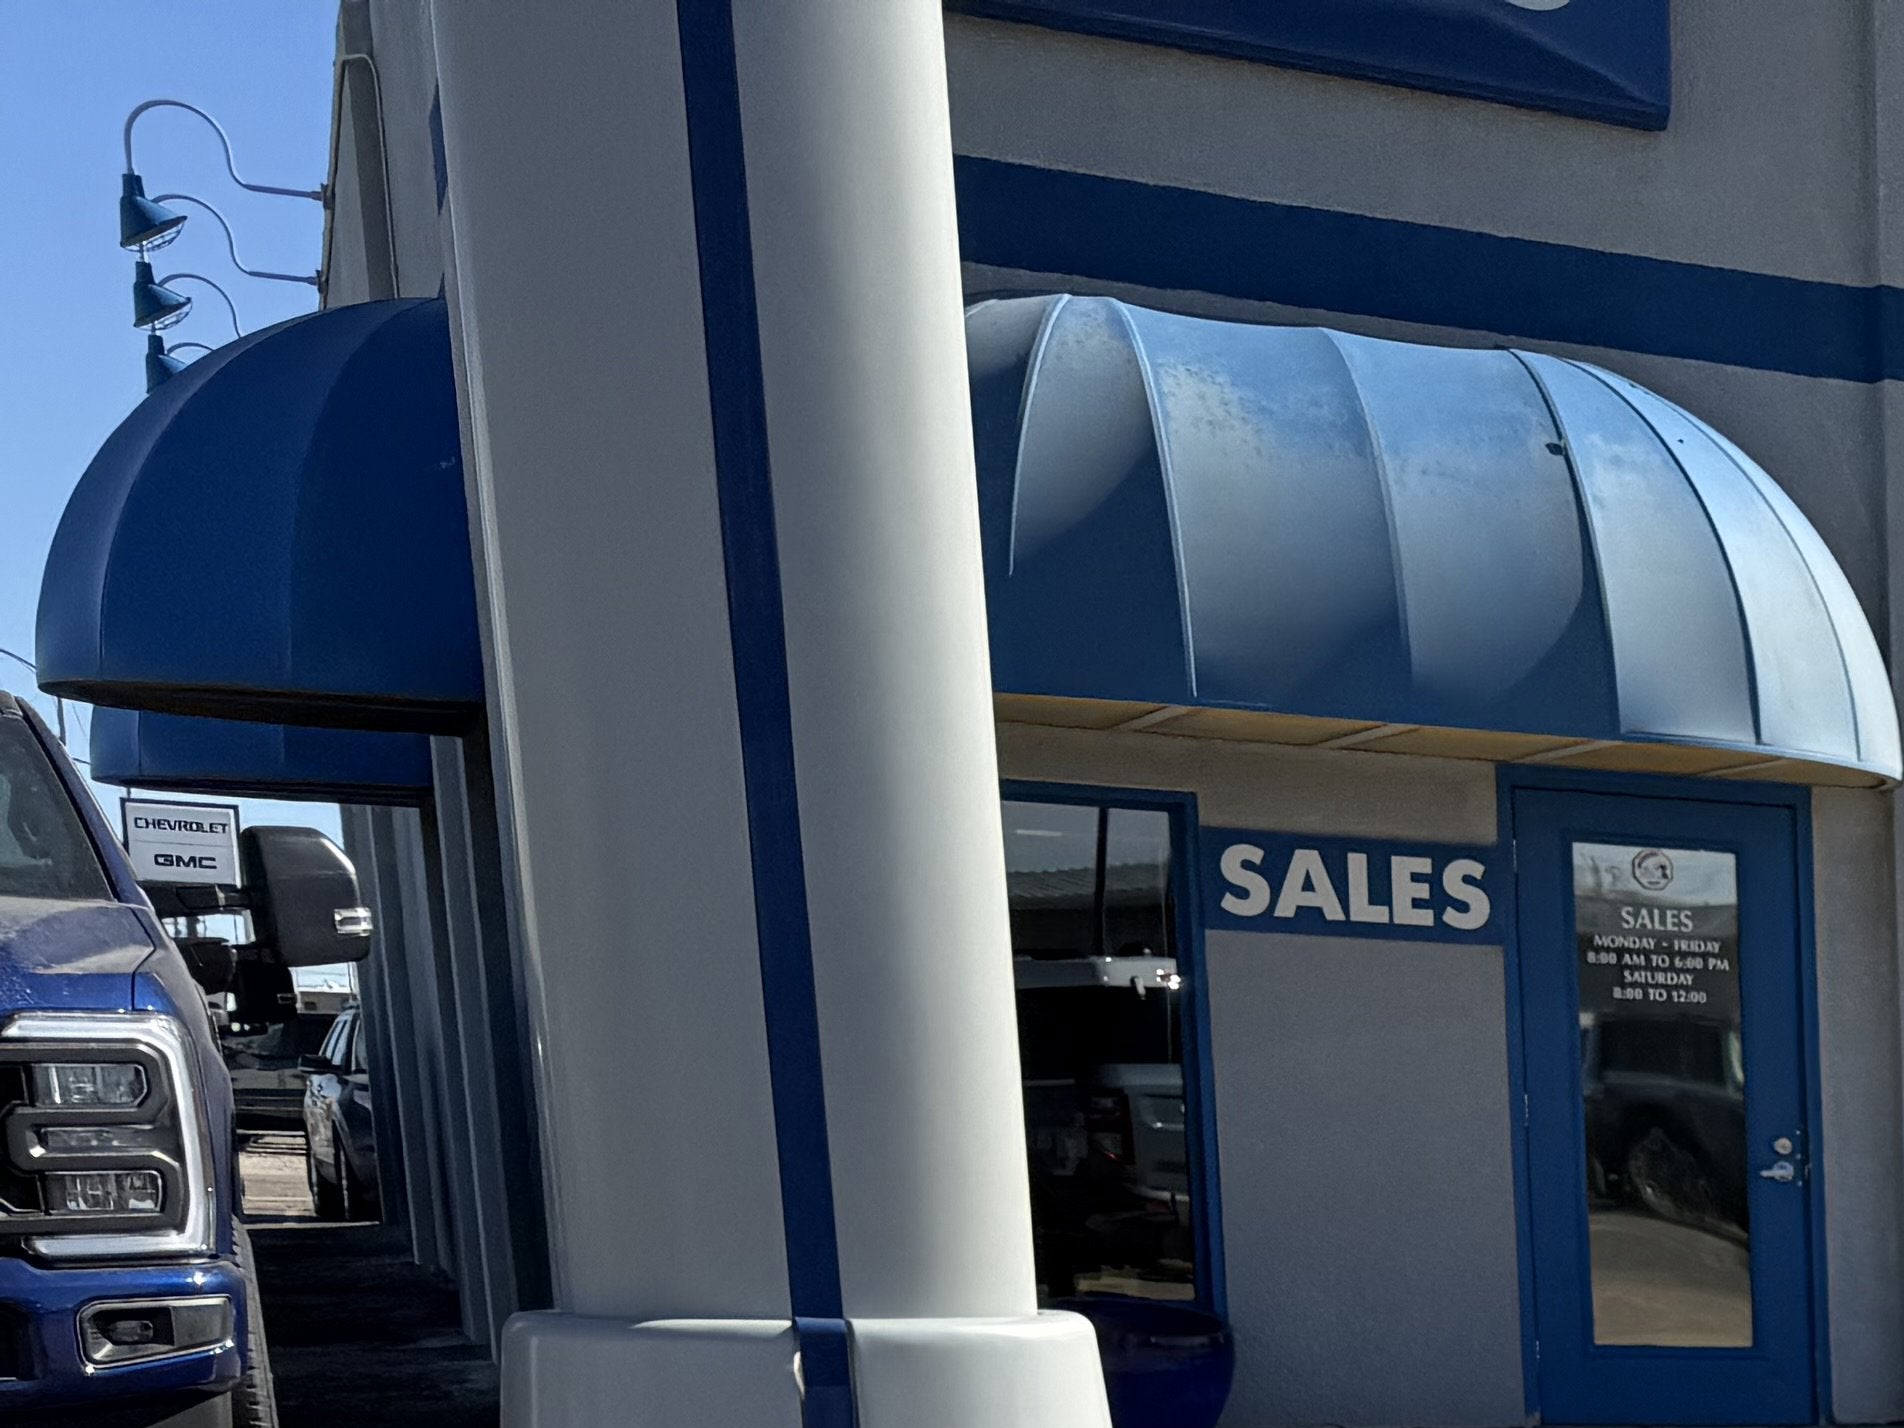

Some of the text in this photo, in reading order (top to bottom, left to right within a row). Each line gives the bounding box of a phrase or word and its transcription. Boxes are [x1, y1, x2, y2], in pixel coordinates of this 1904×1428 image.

[134, 817, 228, 834] CHEVROLET
[154, 854, 217, 869] GMC
[1220, 843, 1491, 931] SALES
[1620, 906, 1694, 933] SALES
[1593, 934, 1657, 950] MONDAY
[1674, 939, 1722, 954] FRIDAY
[1621, 953, 1646, 967] AM
[1650, 954, 1670, 968] TO
[1674, 956, 1704, 970] 6:00
[1708, 958, 1730, 971] PM
[1623, 970, 1695, 986] SATURDAY
[1648, 987, 1668, 1001] TO
[1671, 990, 1707, 1004] 12:00
